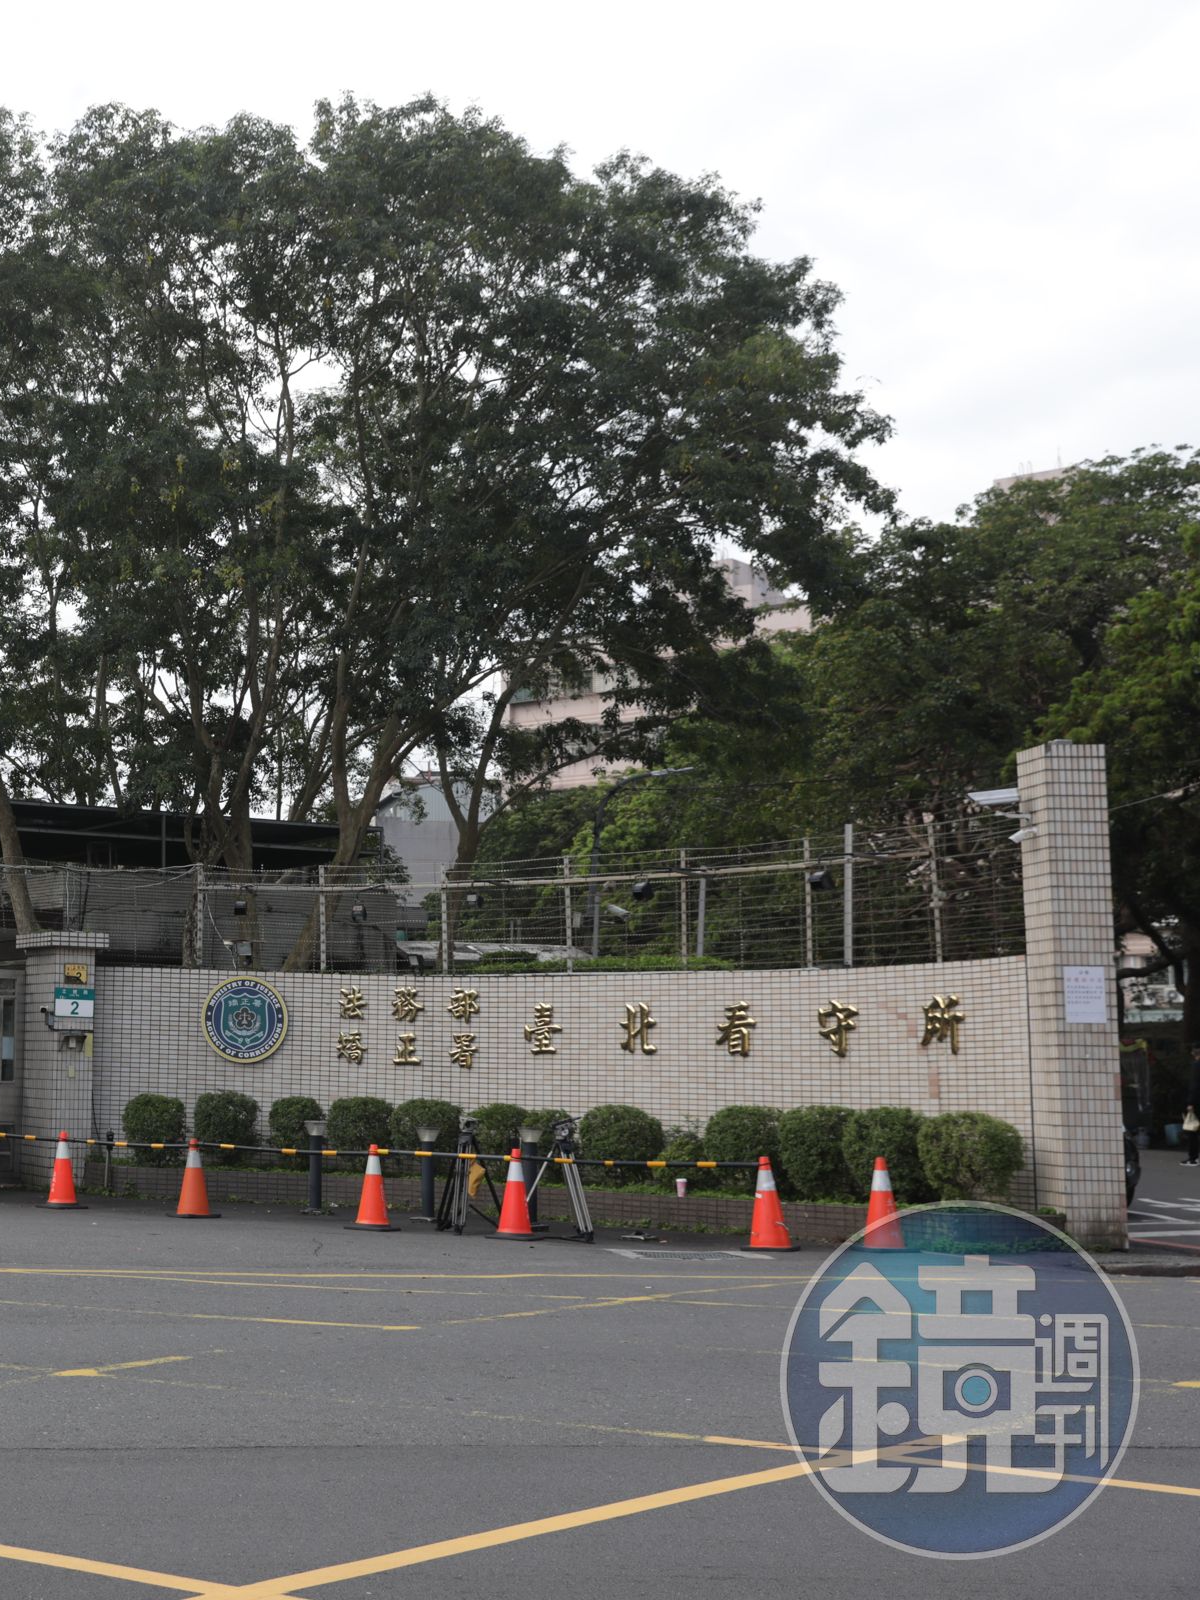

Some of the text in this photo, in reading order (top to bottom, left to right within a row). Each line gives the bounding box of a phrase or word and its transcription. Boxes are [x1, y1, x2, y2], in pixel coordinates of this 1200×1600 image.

[70, 1000, 80, 1015] 2
[210, 980, 243, 1007] MINISTRY
[255, 983, 281, 1009] JUSTICE
[338, 985, 481, 1024] 法務部
[206, 1020, 283, 1058] AGENCY OF CORRECTIONS
[524, 994, 966, 1058] 臺北看守所
[336, 1030, 479, 1070] 矯正署
